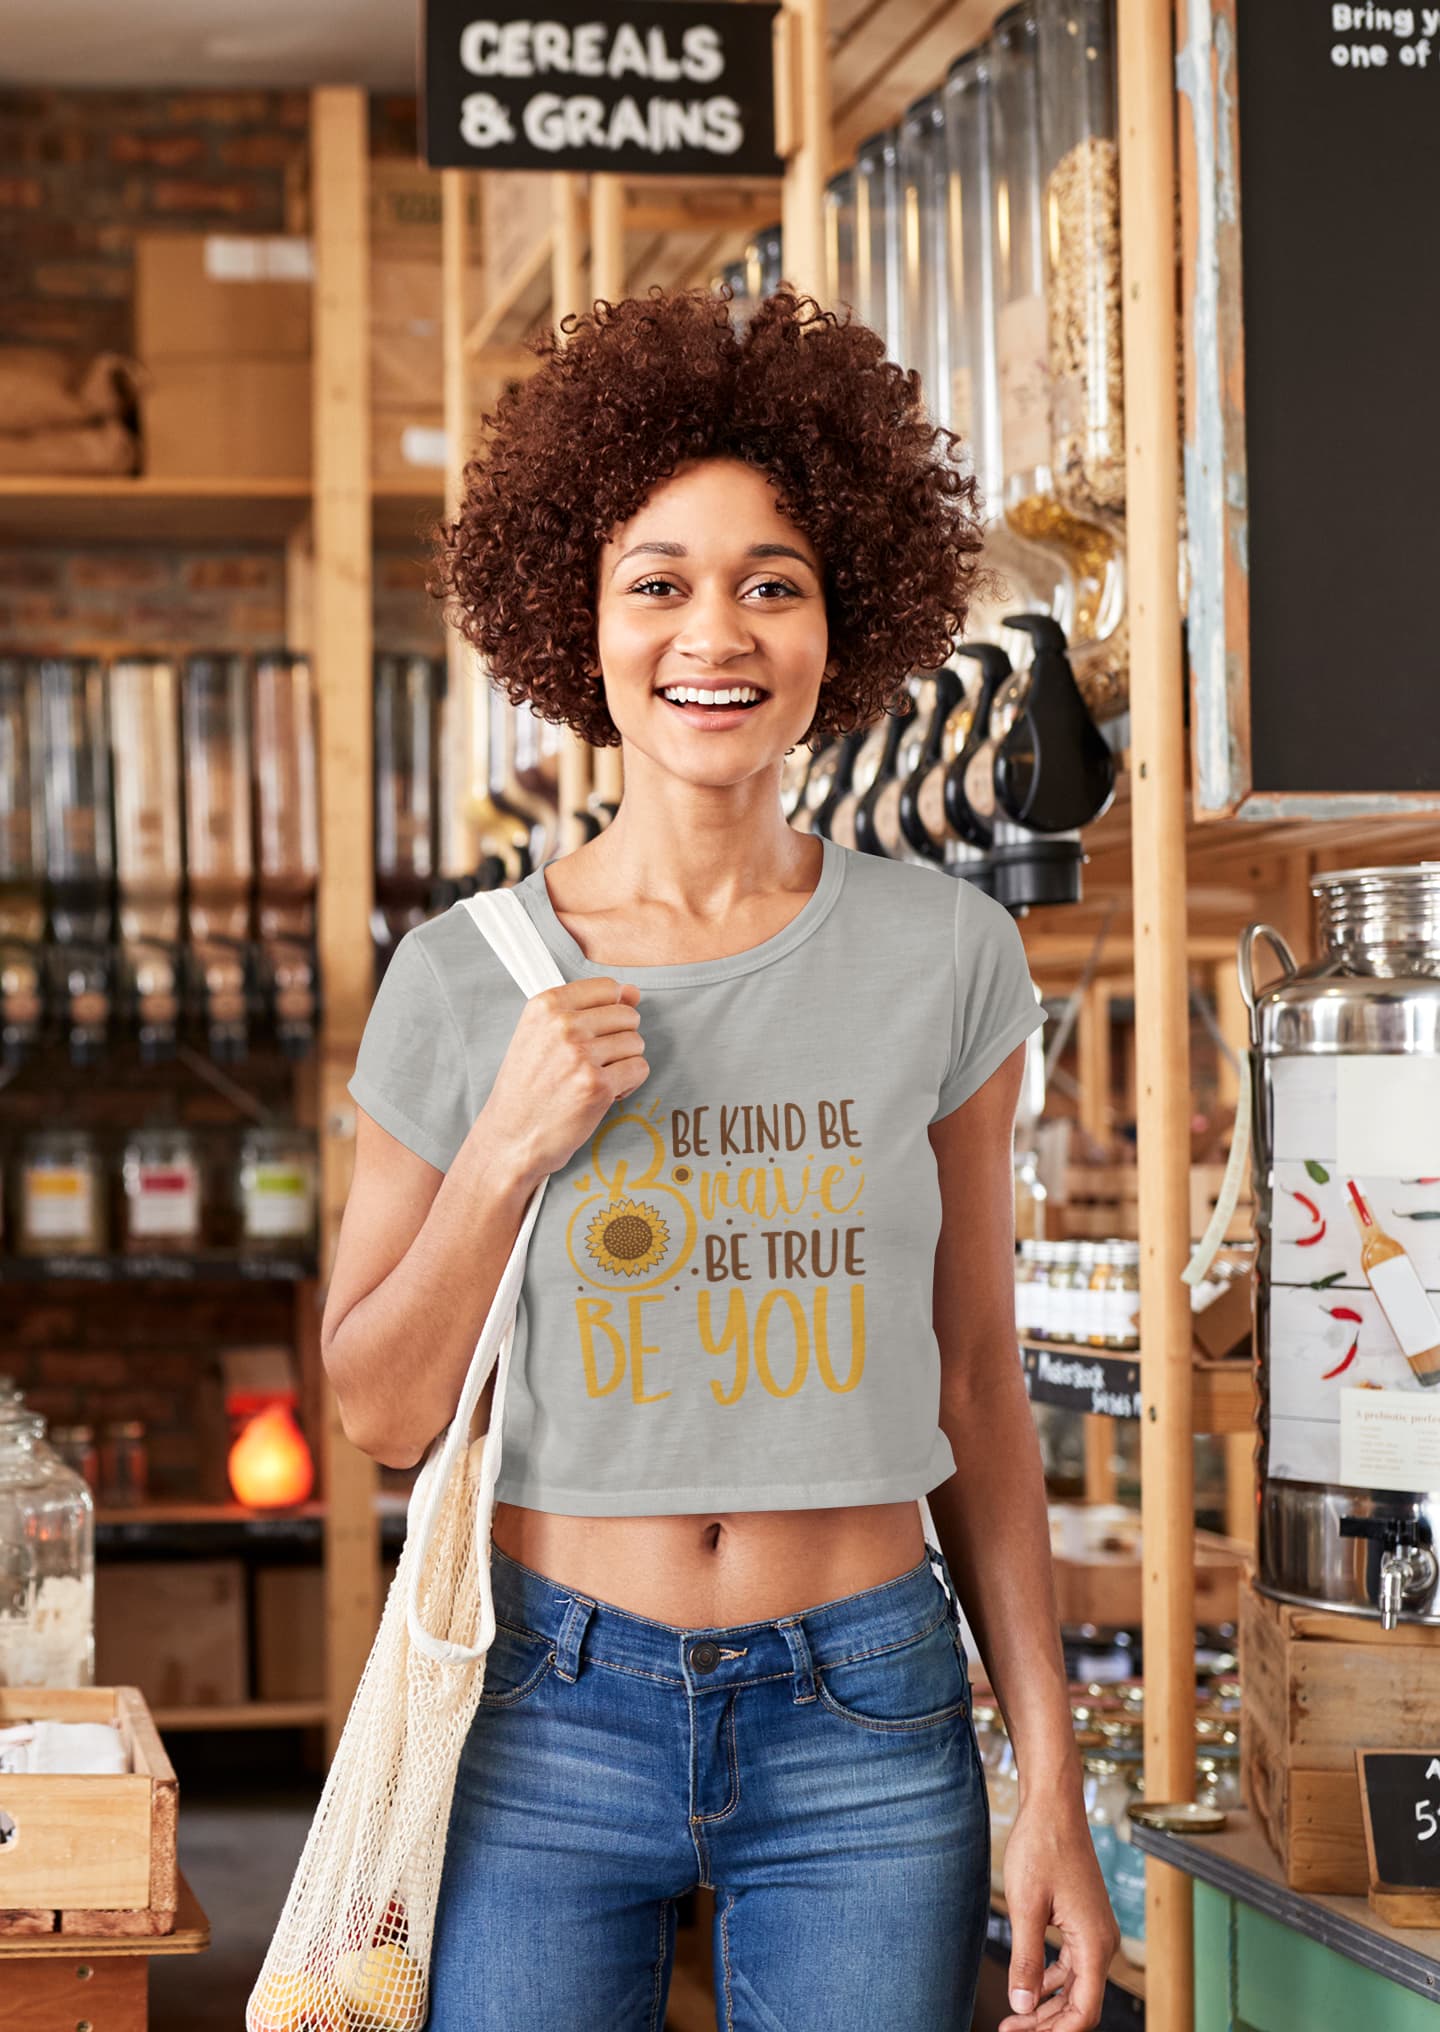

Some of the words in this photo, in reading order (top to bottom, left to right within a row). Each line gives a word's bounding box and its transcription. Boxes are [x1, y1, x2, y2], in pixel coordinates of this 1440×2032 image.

[1332, 1, 1414, 38] Bring
[460, 20, 725, 83] CEREALS
[1331, 44, 1389, 68] one
[1399, 38, 1431, 68] of
[460, 93, 516, 149] &
[523, 93, 744, 154] GRAINS
[671, 1105, 710, 1158] BE
[720, 1102, 806, 1155] KIND
[817, 1098, 863, 1150] BE
[704, 1233, 752, 1283] BE
[761, 1227, 866, 1280] TRUE
[574, 1294, 672, 1406] BE
[697, 1283, 867, 1407] YOU
